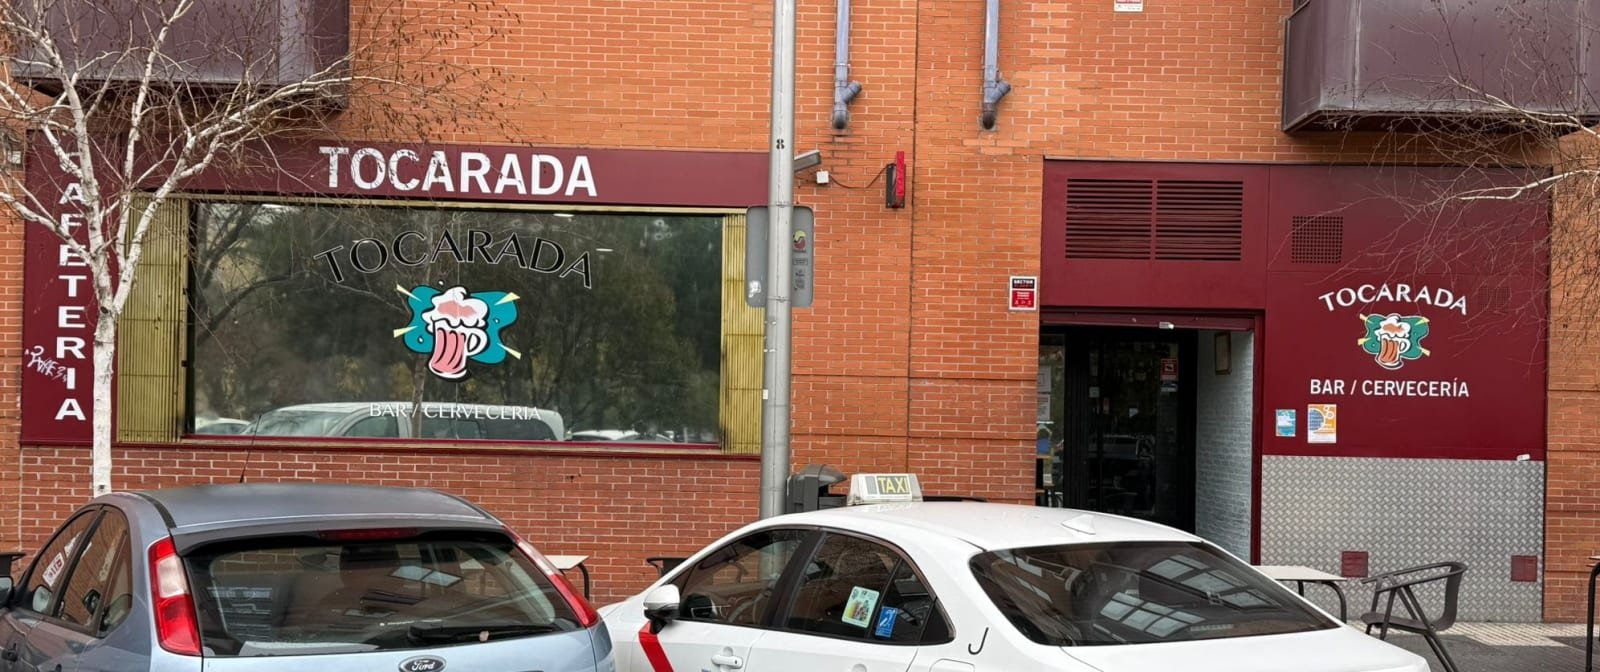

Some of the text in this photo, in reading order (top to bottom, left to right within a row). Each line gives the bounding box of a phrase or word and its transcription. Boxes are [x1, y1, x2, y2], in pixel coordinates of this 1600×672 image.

[319, 146, 597, 197] TOCARADA
[313, 229, 592, 289] TOCARADA
[1318, 283, 1467, 316] TOCARADA
[1310, 378, 1469, 397] BAR / CERVECERÍA
[369, 403, 408, 417] BAR
[411, 404, 419, 418] /
[877, 477, 909, 494] TAXI
[411, 660, 436, 671] Ford
